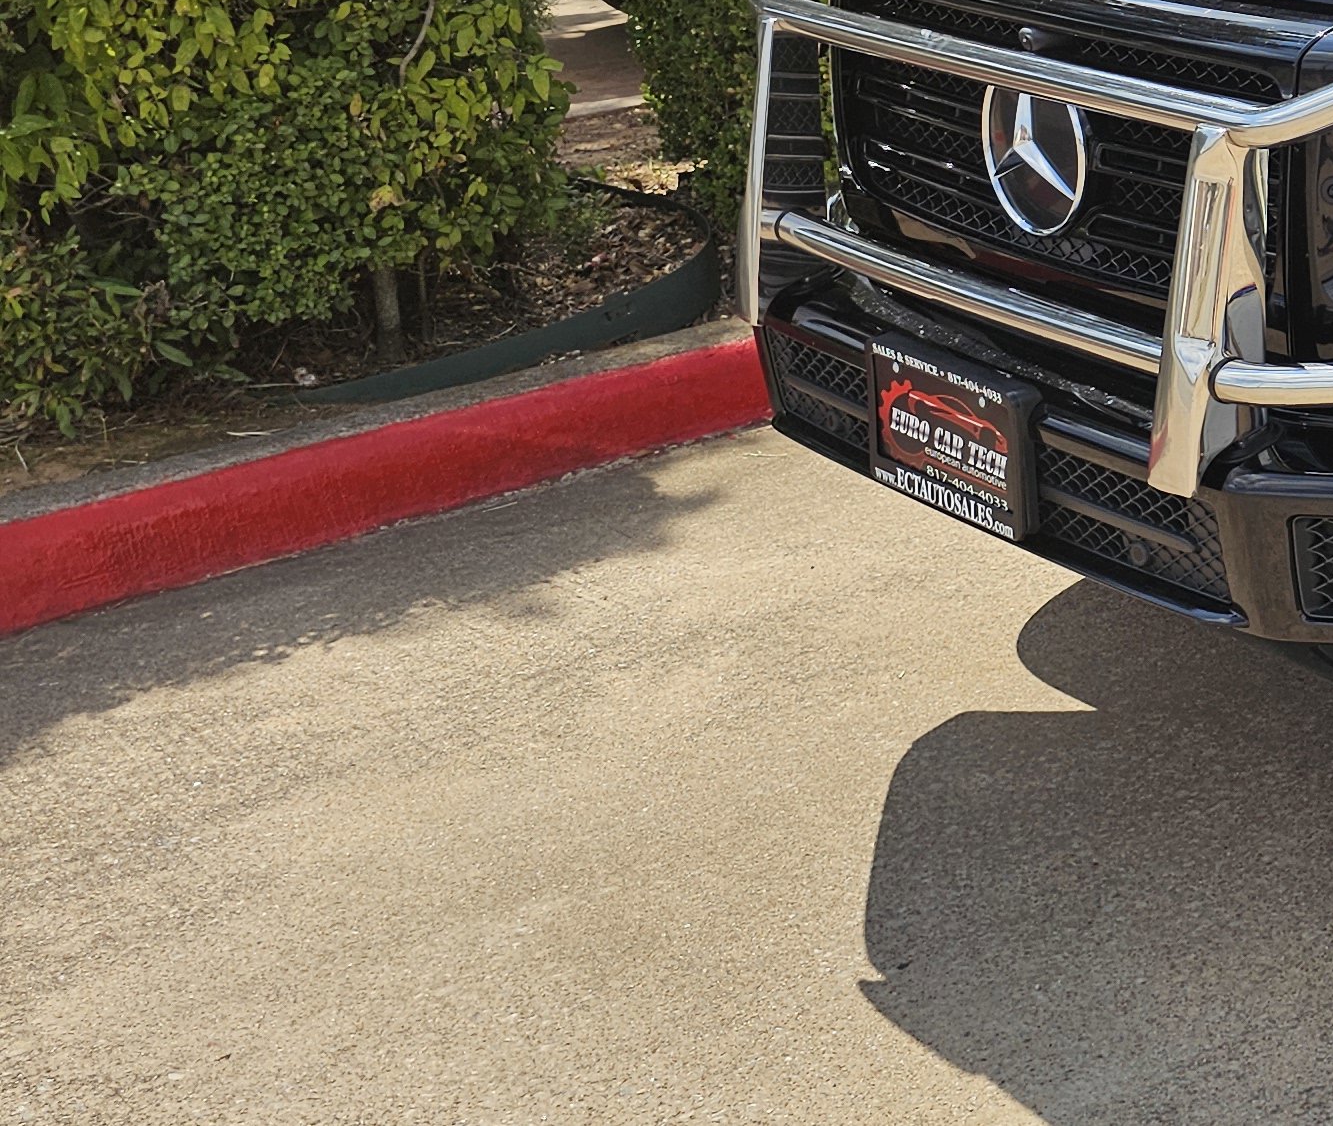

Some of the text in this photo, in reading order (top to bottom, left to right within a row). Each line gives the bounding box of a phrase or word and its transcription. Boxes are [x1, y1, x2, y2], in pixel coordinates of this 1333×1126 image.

[872, 342, 897, 361] SALES
[904, 354, 939, 377] SERVICE
[947, 371, 1003, 404] 817-404-4033
[890, 407, 1009, 480] EURO CAR TECH
[924, 446, 1008, 492] european automotive
[874, 467, 1014, 539] www.ECTAUTOSALES.com
[926, 465, 1009, 512] 817-404-4033
